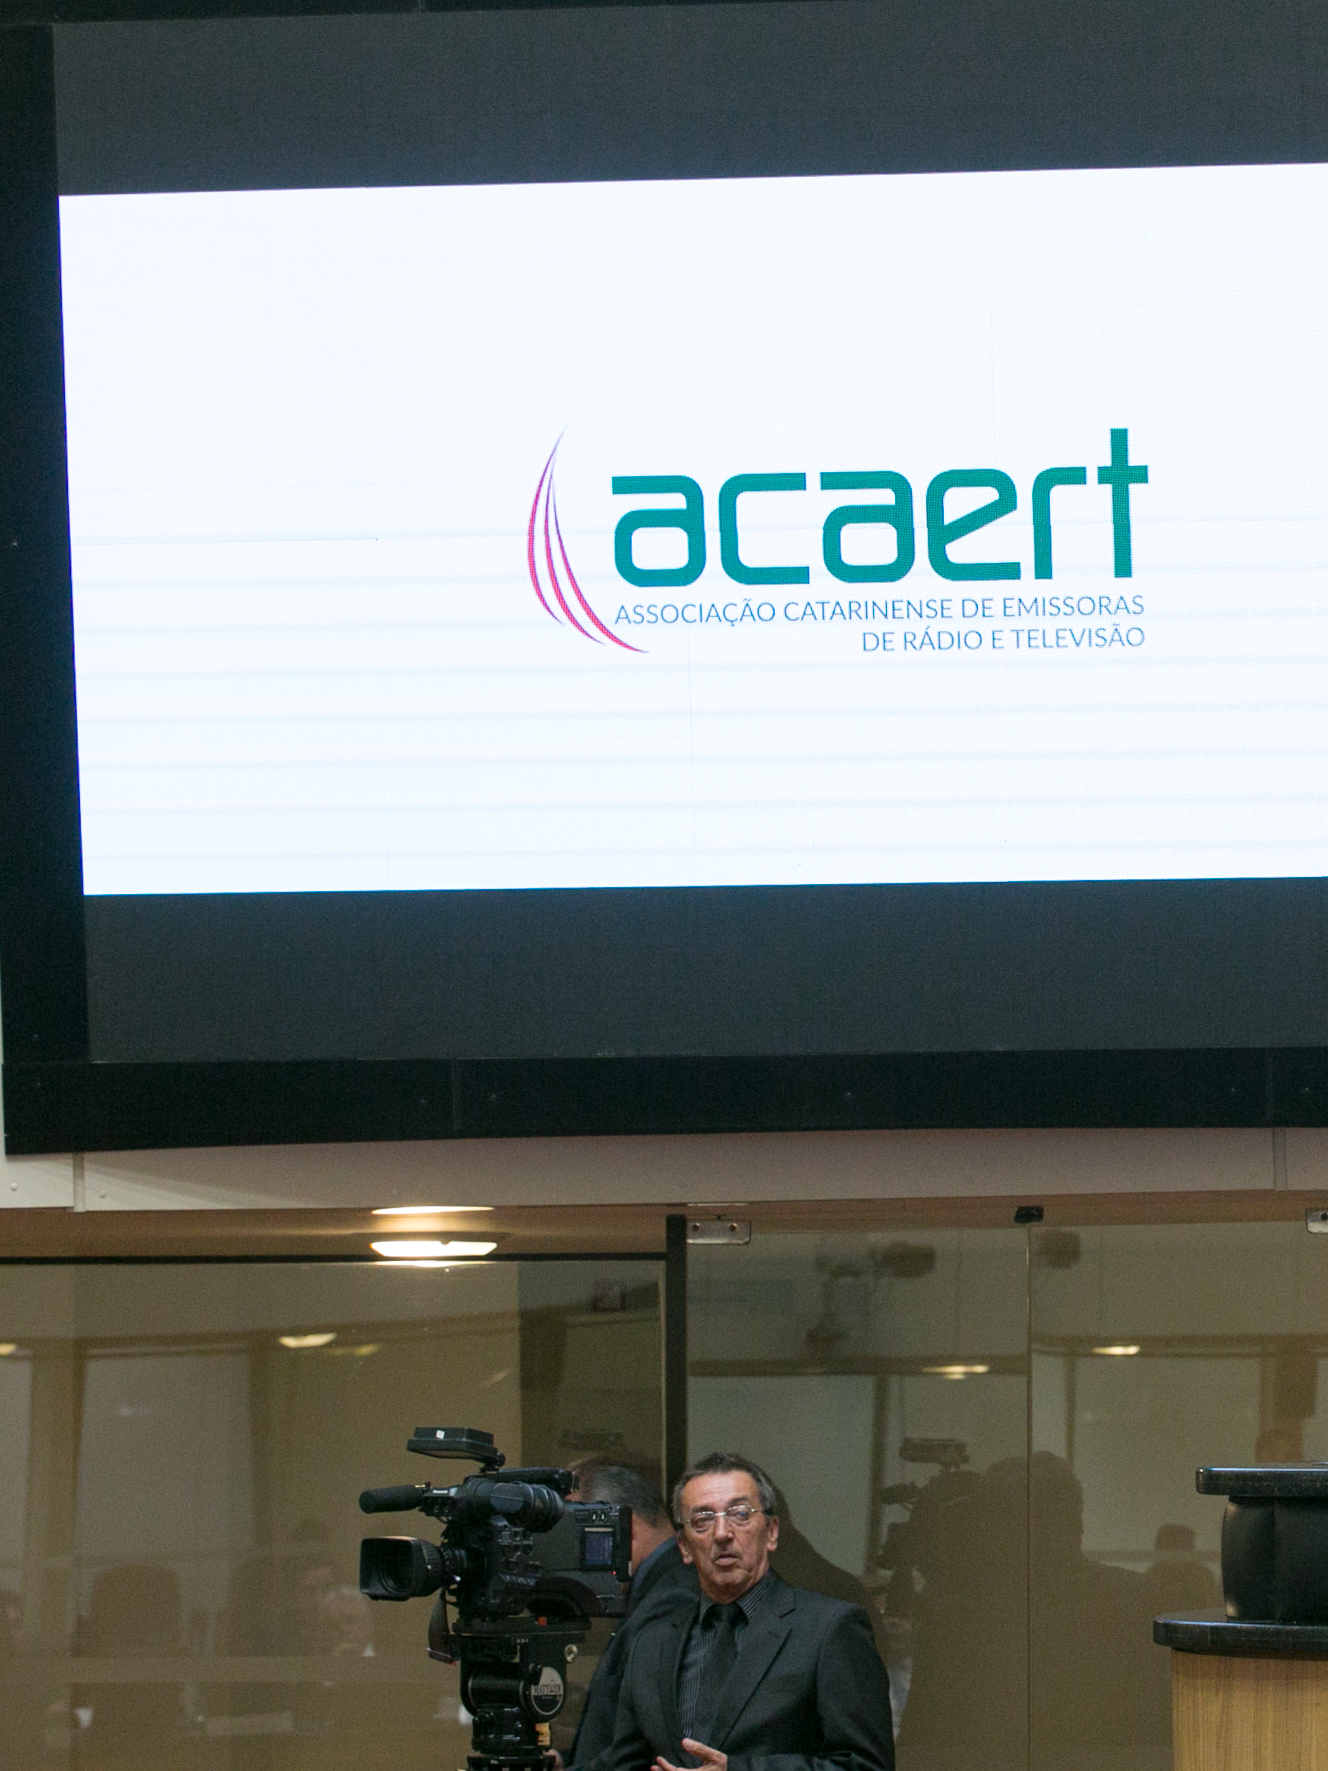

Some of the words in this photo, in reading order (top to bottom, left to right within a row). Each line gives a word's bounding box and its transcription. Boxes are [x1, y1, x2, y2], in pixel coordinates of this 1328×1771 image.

[611, 428, 1149, 588] acaert
[614, 598, 776, 627] ASSOCIAÇÃO
[784, 598, 952, 622] CATARINENSE
[962, 598, 995, 619] DE
[1003, 595, 1145, 617] EMISSORAS
[862, 631, 895, 651] DE
[904, 626, 983, 651] RÁDIO
[991, 630, 1004, 649] E
[1010, 623, 1145, 648] TELEVISÃO
